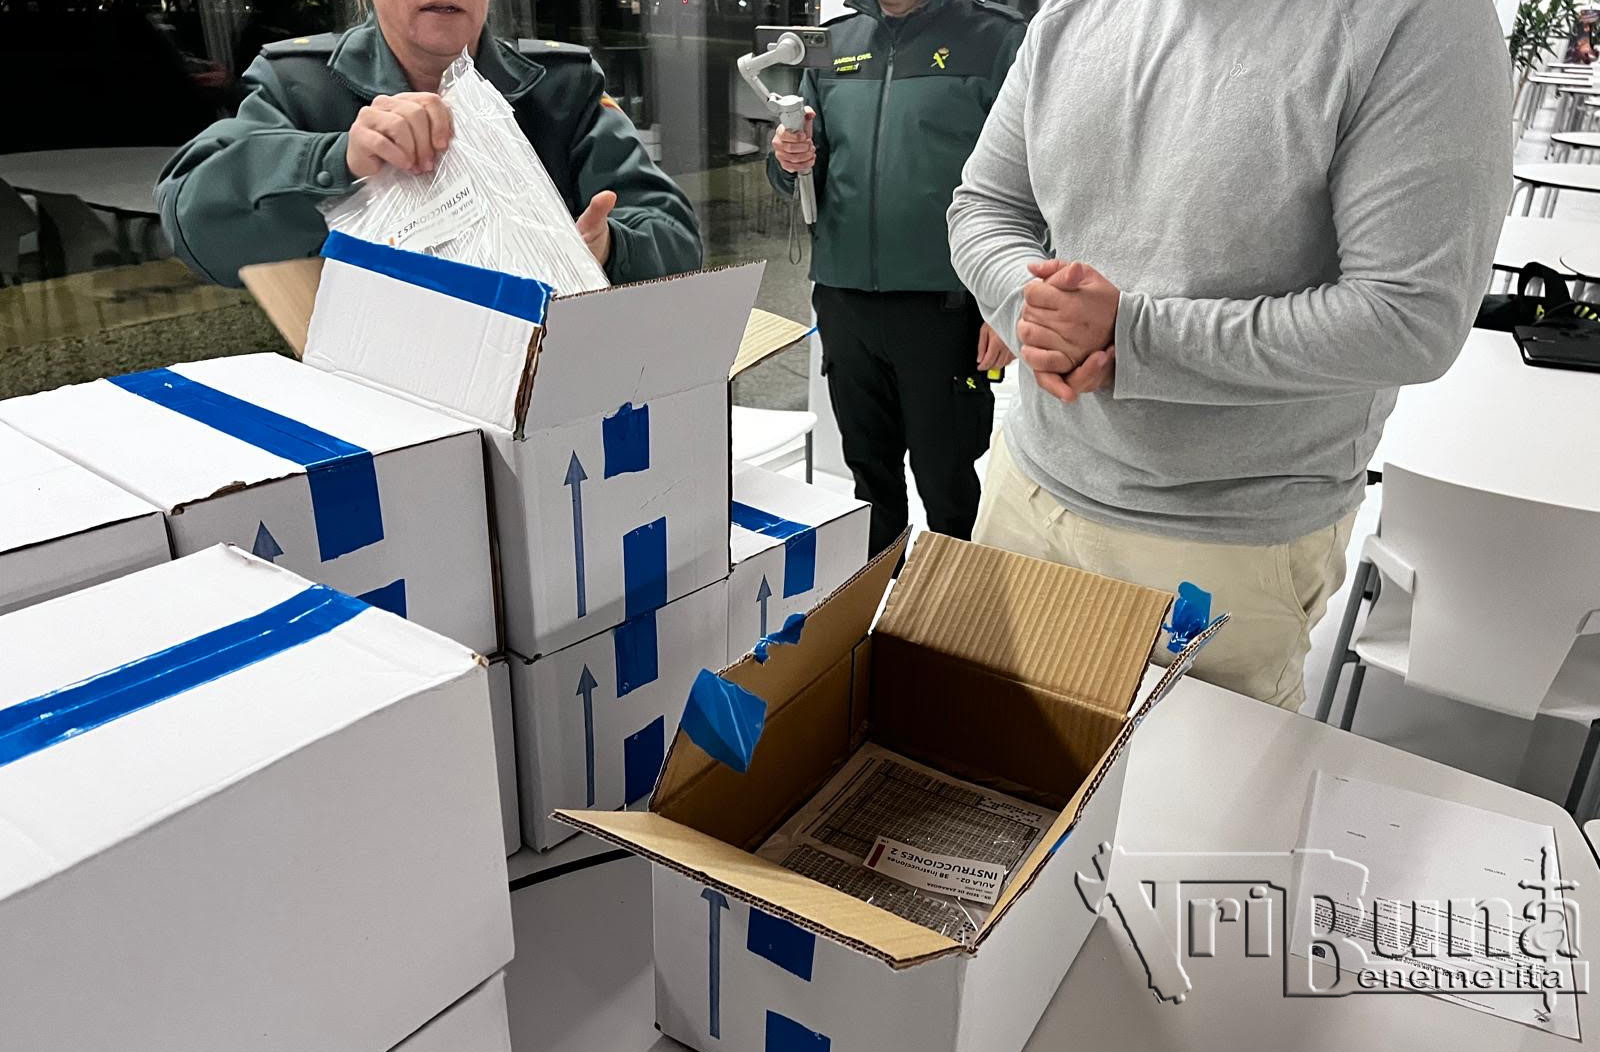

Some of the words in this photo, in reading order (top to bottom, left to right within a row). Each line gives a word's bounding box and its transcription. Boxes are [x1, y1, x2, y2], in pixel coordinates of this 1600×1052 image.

[403, 186, 470, 234] INSTRUCCIONES
[890, 847, 899, 856] 2
[887, 856, 938, 879] Instrucciones
[901, 850, 998, 881] INSTRUCCIONES
[972, 880, 995, 889] AULA
